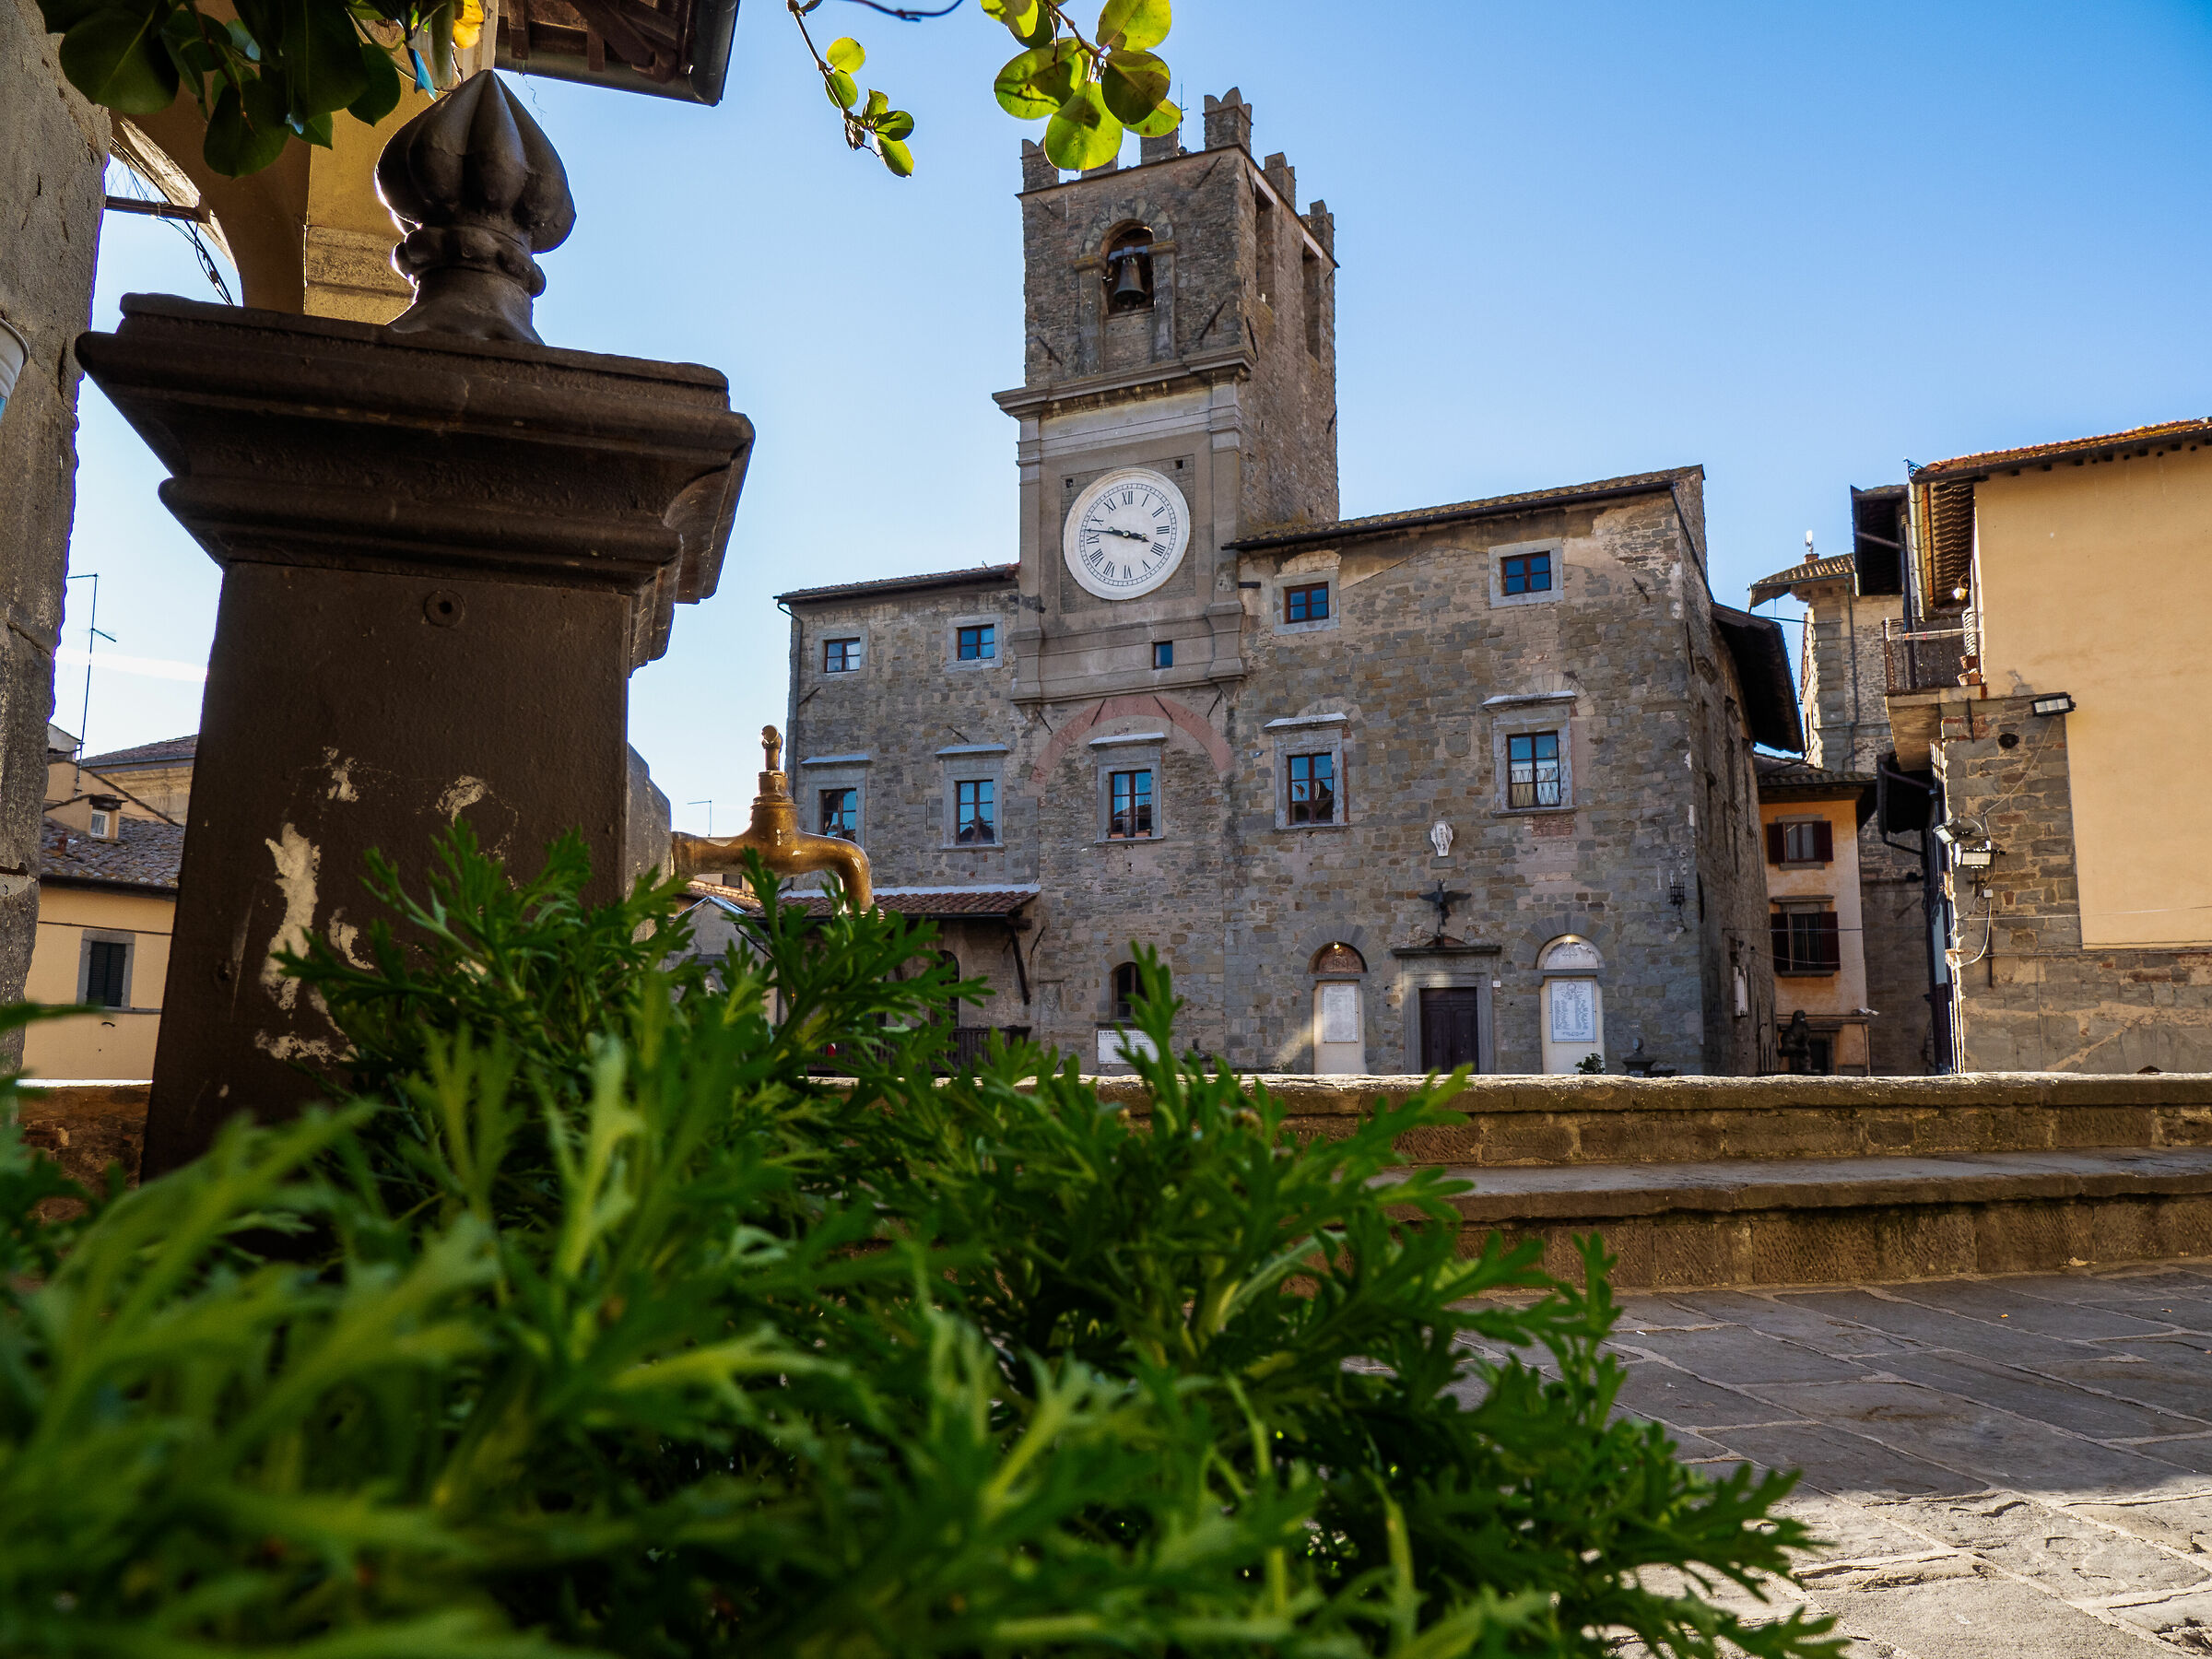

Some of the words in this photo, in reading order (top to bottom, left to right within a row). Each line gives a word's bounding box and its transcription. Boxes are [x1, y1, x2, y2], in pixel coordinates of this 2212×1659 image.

[1122, 491, 1133, 506] XII
[1142, 494, 1149, 507] I
[1104, 499, 1116, 513] XI
[1152, 506, 1165, 518] II
[1091, 515, 1103, 525] X
[1157, 525, 1170, 535] III
[1150, 542, 1166, 557] IIII
[1089, 548, 1104, 567] VIII
[1103, 561, 1115, 577] VII
